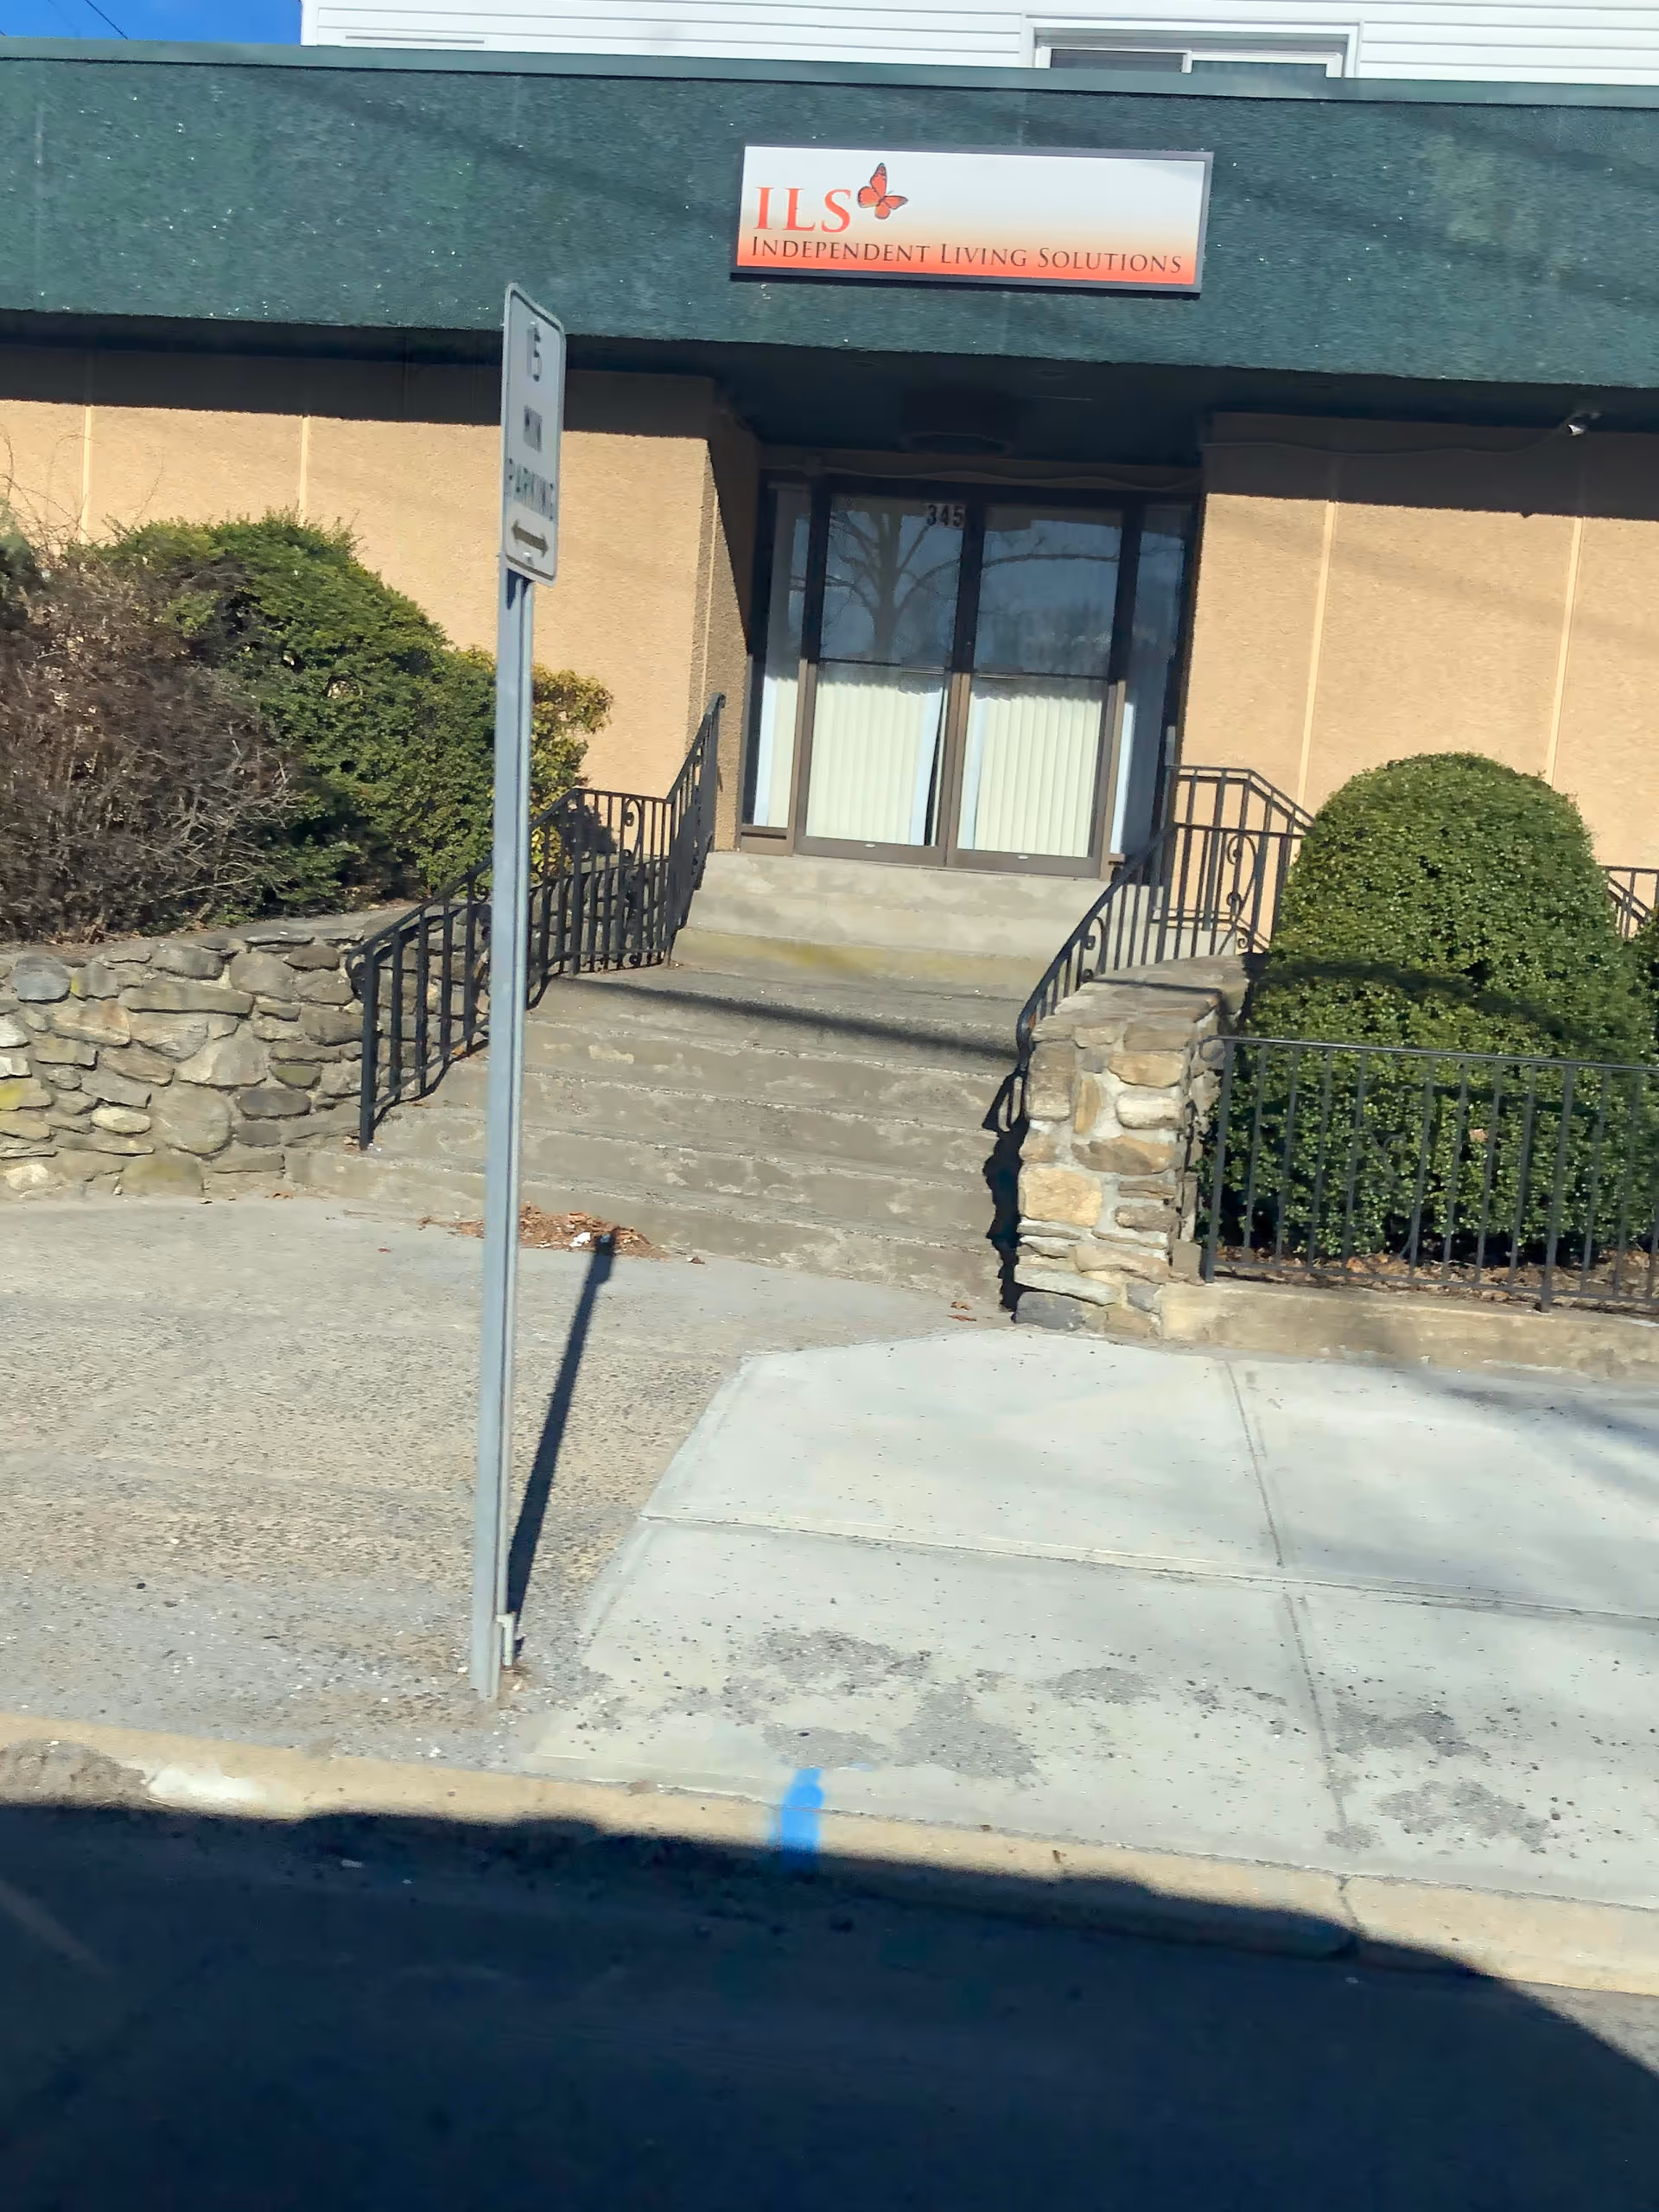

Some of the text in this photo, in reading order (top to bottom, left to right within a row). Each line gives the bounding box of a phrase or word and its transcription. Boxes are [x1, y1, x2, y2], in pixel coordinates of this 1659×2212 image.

[753, 186, 852, 233] ILS
[751, 236, 1182, 274] INDEPENDENT LIVING SOLUTIONS
[505, 458, 557, 524] PARKING
[925, 504, 963, 527] 345
